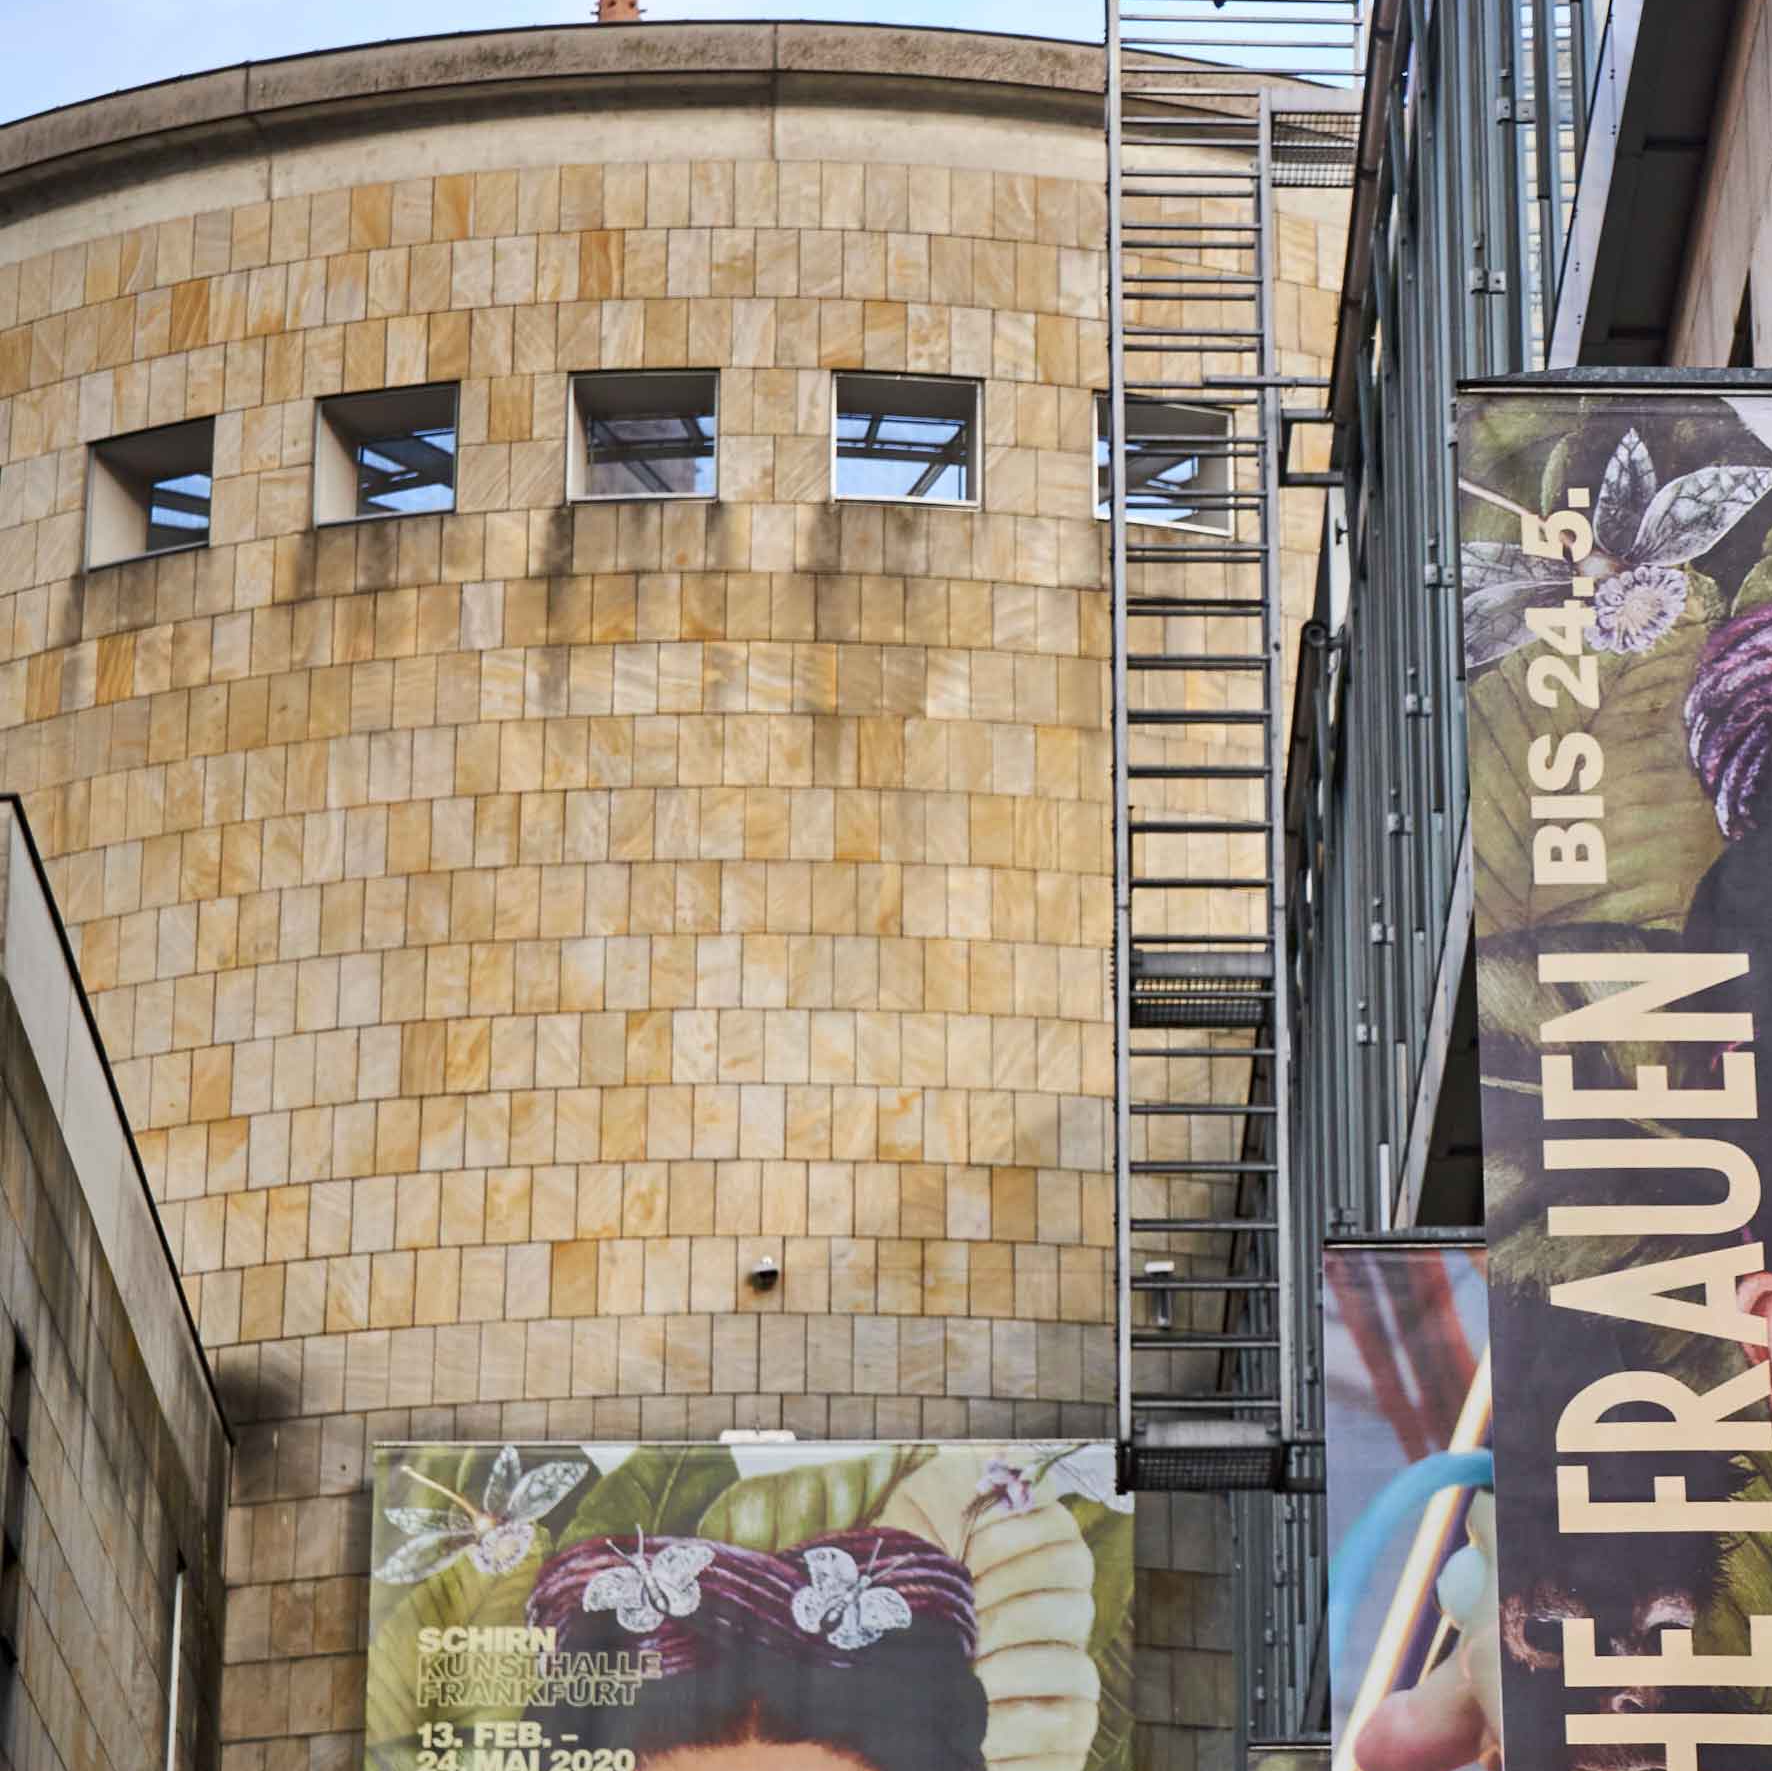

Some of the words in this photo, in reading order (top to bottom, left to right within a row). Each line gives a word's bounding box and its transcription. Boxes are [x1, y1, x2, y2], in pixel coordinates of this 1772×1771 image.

[1527, 731, 1607, 885] BIS
[417, 1626, 558, 1653] SCHIRN
[416, 1651, 663, 1679] KUNSTHALLE
[416, 1678, 643, 1707] FRANKFURT
[416, 1721, 464, 1749] 13.
[473, 1721, 552, 1749] FEB.
